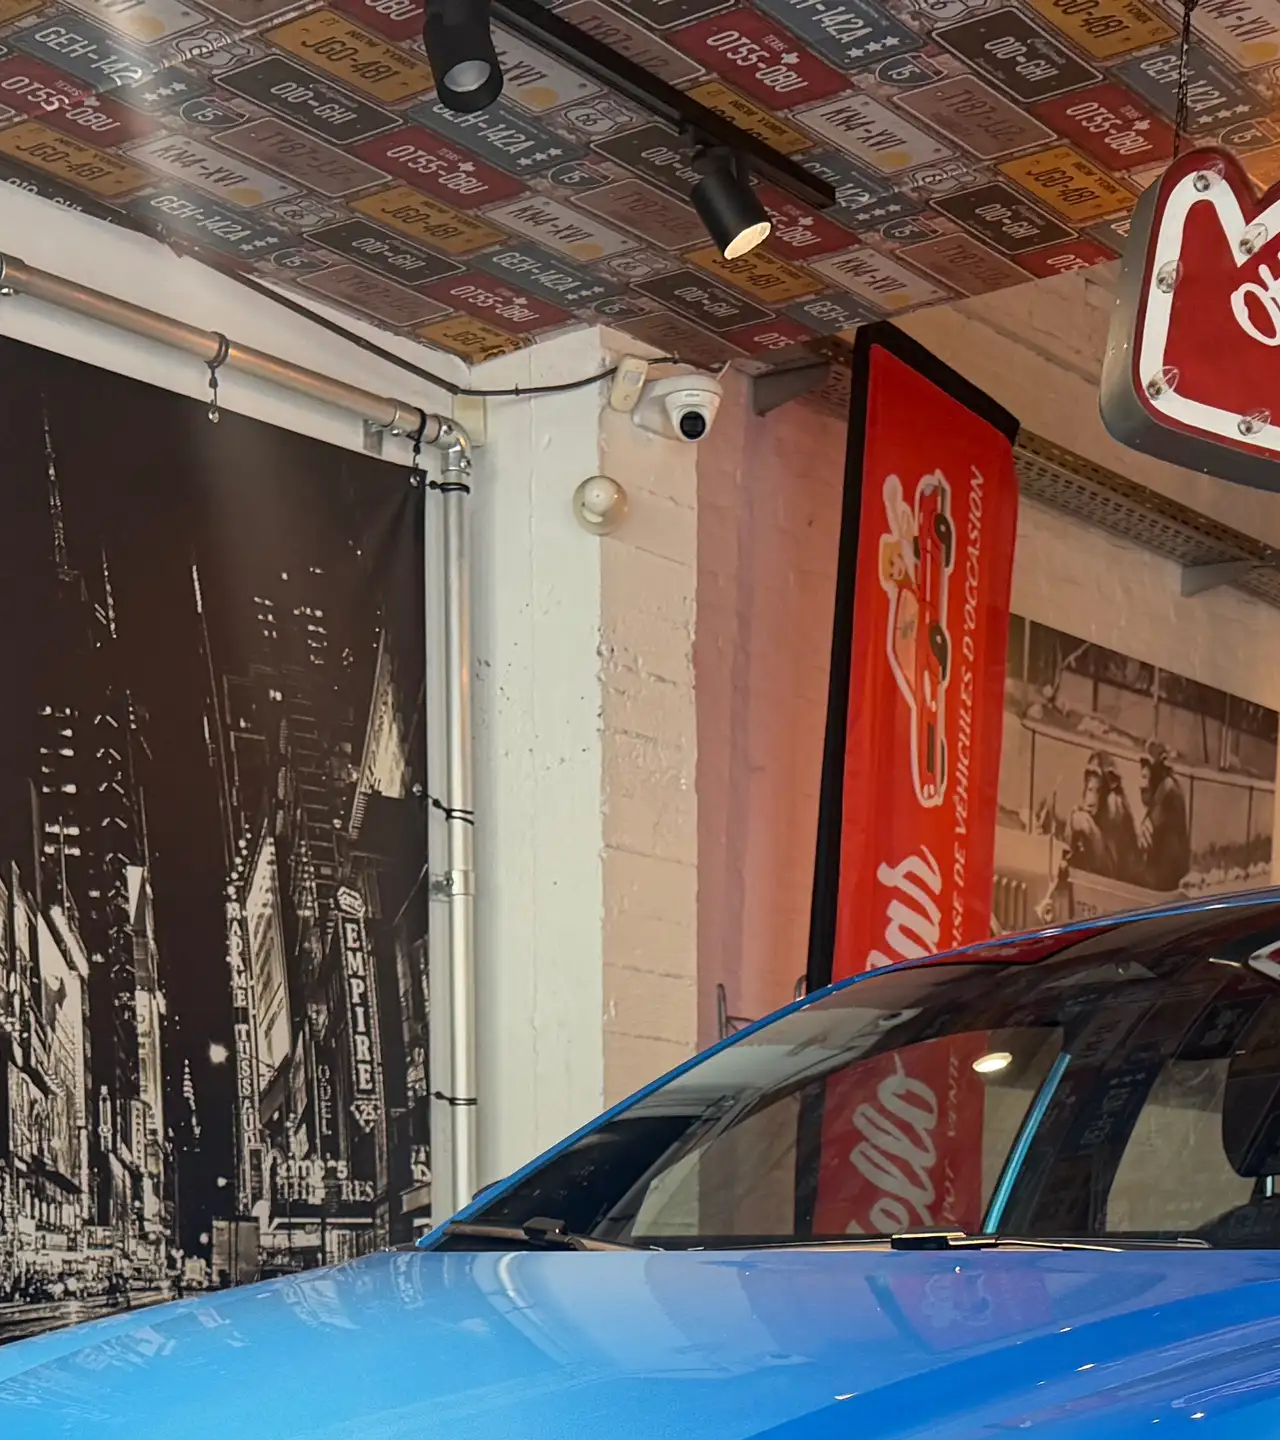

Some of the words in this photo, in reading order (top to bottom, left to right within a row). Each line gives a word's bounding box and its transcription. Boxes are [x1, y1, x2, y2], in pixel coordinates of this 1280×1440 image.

[888, 64, 918, 80] 15
[192, 107, 223, 122] 15
[575, 111, 604, 127] 66
[559, 168, 587, 184] 15
[893, 226, 919, 238] 15
[281, 255, 308, 267] 15
[963, 464, 985, 662] D'OCCASION
[952, 665, 974, 835] VÉHICULES
[953, 841, 968, 887] DE
[342, 920, 376, 1092] EMPIRE
